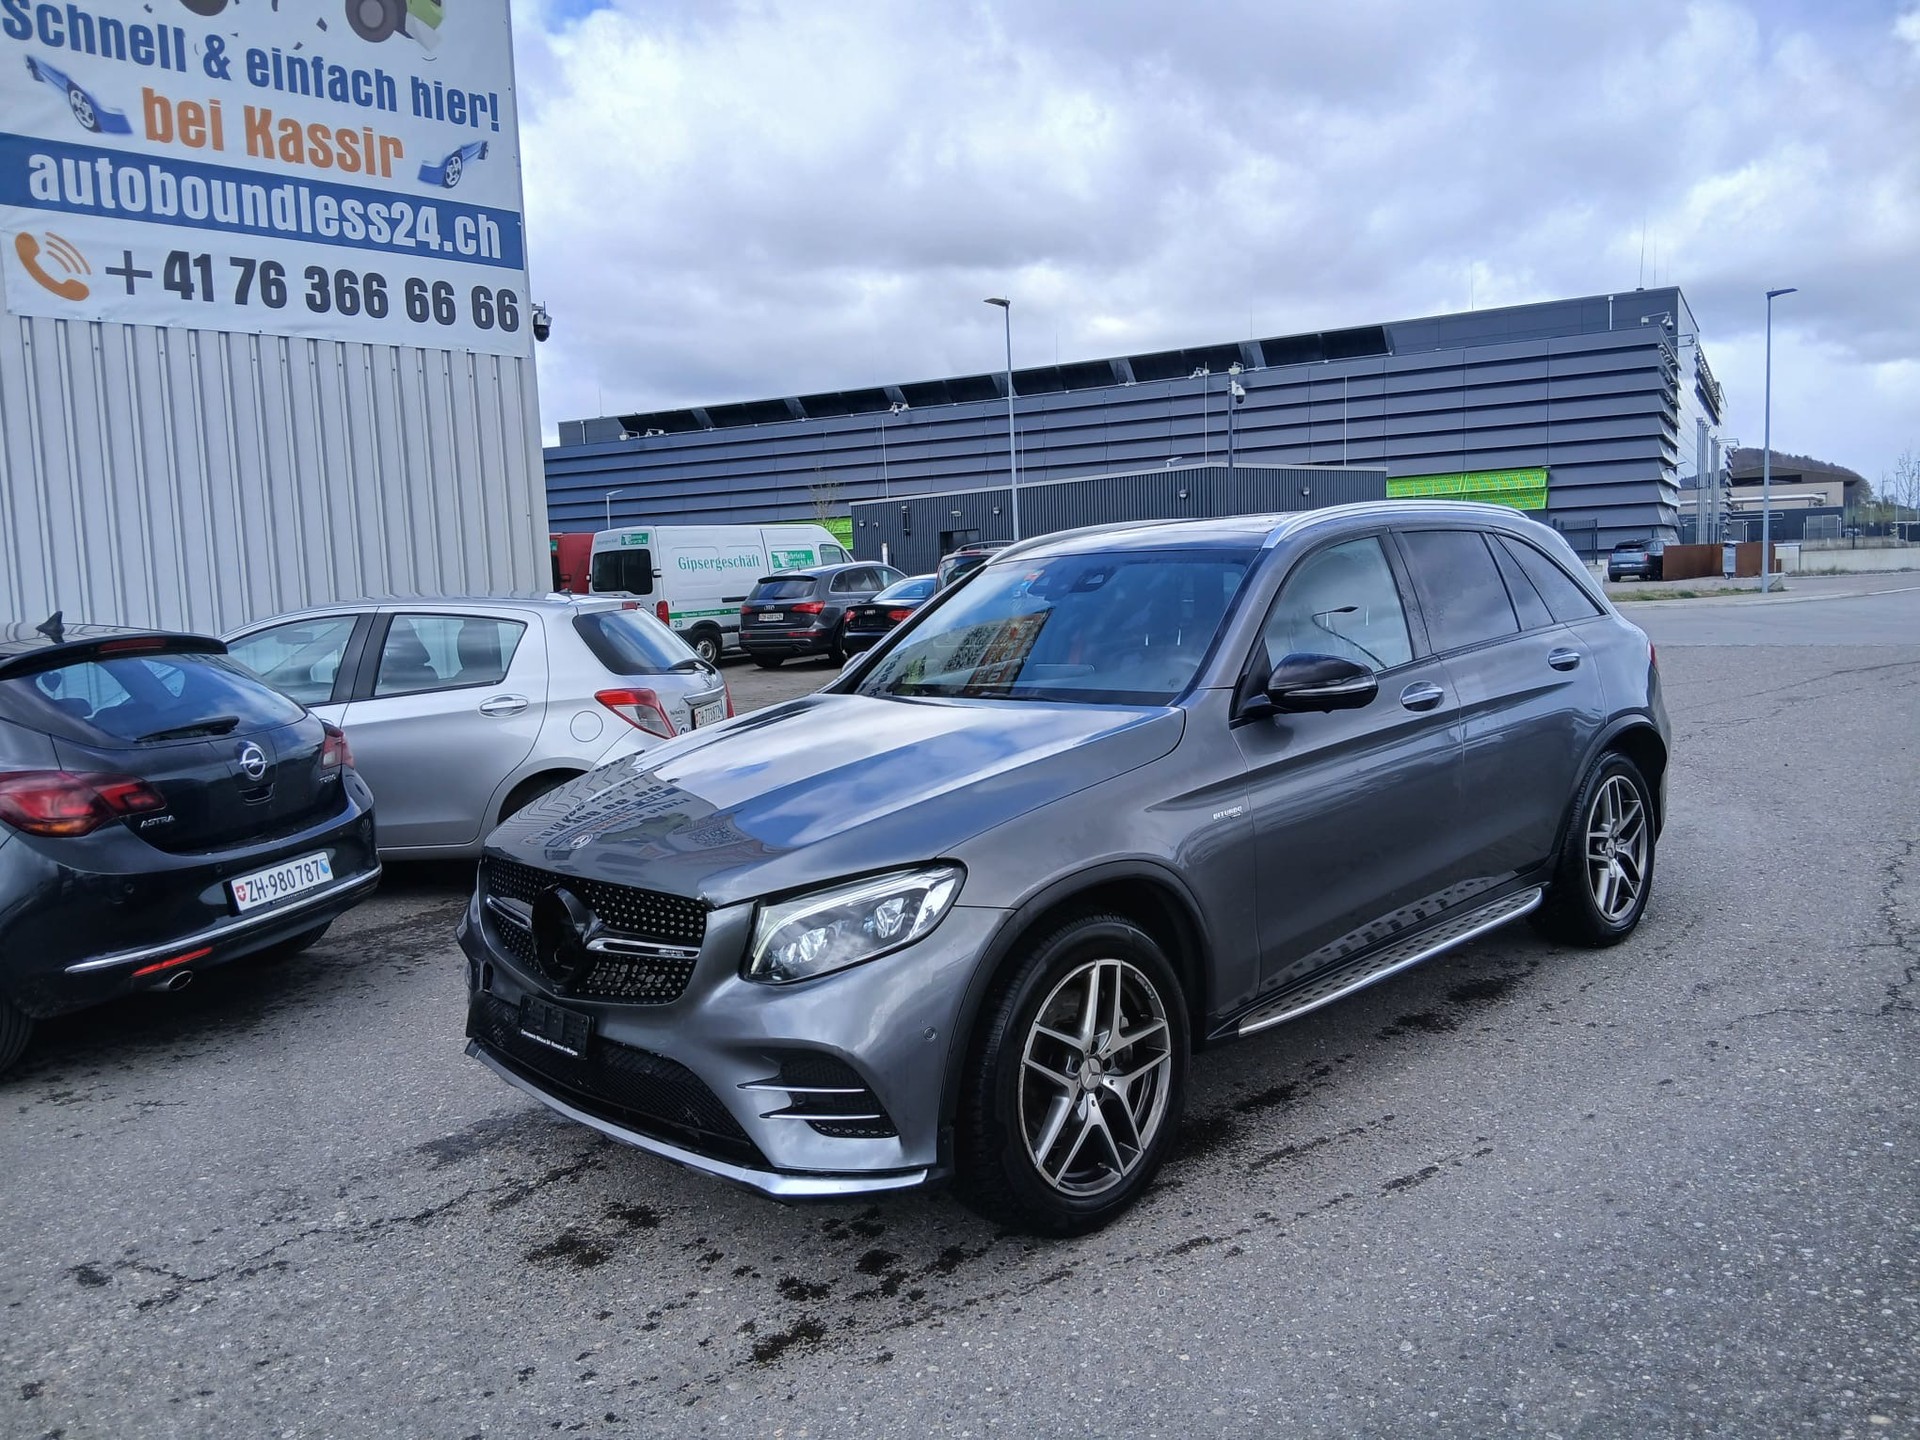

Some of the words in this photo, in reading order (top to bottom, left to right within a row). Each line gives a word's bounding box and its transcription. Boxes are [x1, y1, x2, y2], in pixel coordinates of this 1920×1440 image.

[1, 0, 187, 72] Schnell
[203, 34, 231, 81] &
[246, 47, 397, 112] einfach
[410, 75, 499, 132] hier!
[142, 87, 224, 151] bei
[243, 105, 404, 178] Kassir
[28, 154, 501, 259] autoboundless24.ch
[230, 256, 287, 309] 76
[304, 265, 389, 319] 366
[404, 277, 456, 326] 66
[471, 285, 519, 333] 66
[678, 555, 760, 572] Gipsergeschäft
[674, 620, 682, 628] 29
[140, 815, 175, 828] ASTRA
